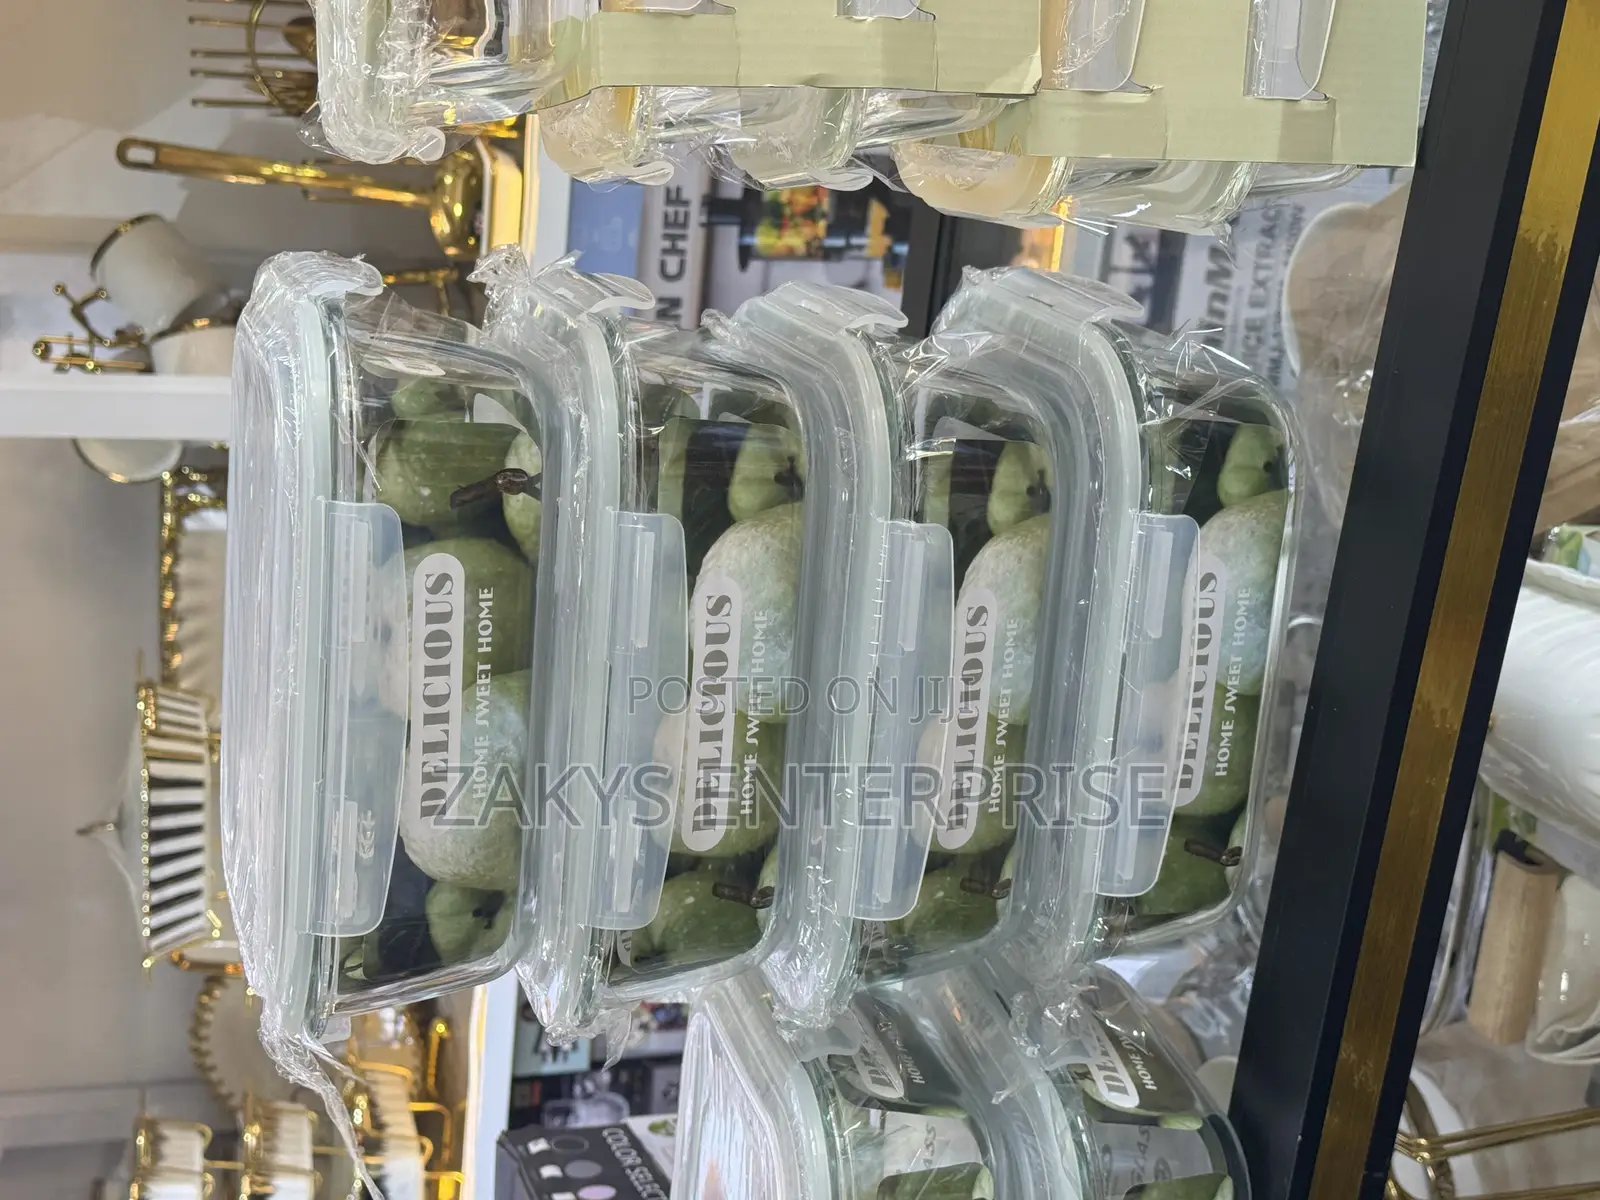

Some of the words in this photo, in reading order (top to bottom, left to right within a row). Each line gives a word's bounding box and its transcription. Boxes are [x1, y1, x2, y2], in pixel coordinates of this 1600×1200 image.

[658, 184, 690, 283] CHEF
[477, 586, 494, 653] HOME
[750, 610, 769, 672] HOME
[1231, 587, 1251, 646] HOME
[1001, 618, 1019, 678] HOME
[419, 571, 454, 820] DELICIOUS
[474, 661, 493, 728] SWEET
[745, 680, 764, 745] SWEET
[1170, 571, 1219, 792] DELICIOUS
[1223, 655, 1244, 714] SWEET
[692, 593, 732, 833] DELICIOUS
[946, 605, 989, 831] DELICIOUS
[994, 685, 1012, 747] SWEET
[472, 736, 490, 799] HOME
[1214, 720, 1236, 776] HOME
[739, 753, 759, 815] HOME
[987, 755, 1006, 812] HOME
[1128, 1052, 1158, 1091] HOME
[601, 1127, 643, 1167] COLOR
